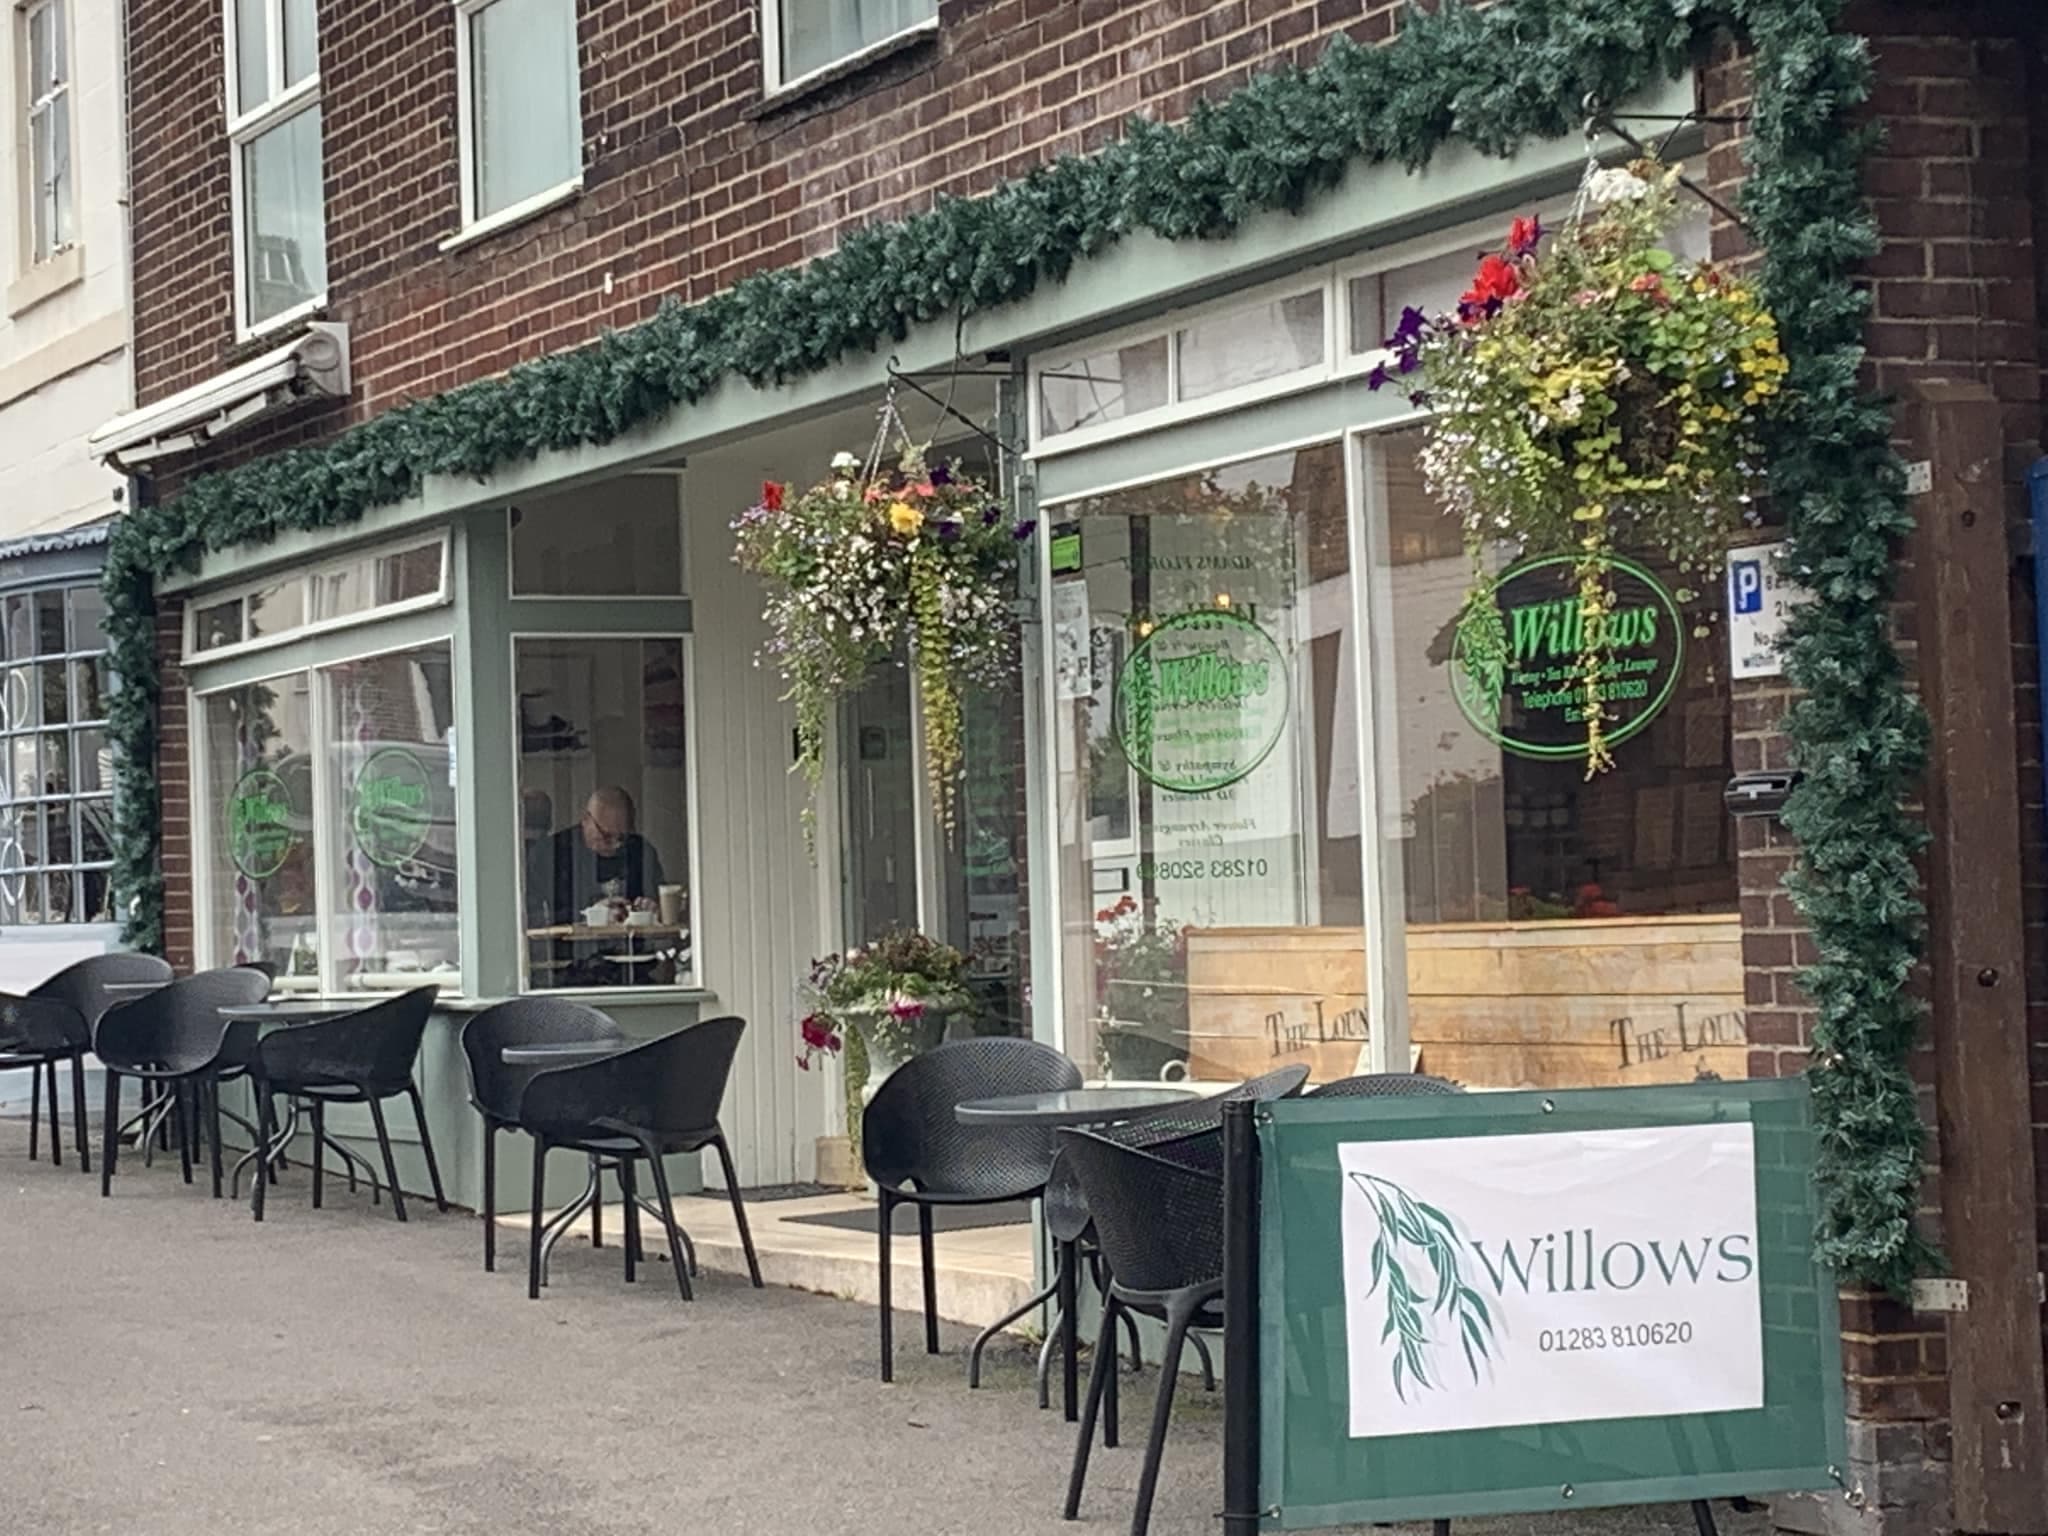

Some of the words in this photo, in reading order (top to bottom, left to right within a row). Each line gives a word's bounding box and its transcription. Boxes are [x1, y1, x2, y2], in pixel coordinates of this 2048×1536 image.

[1511, 598, 1658, 661] Willows
[1160, 652, 1270, 702] Willows
[1469, 1228, 1753, 1297] Willows
[1539, 1328, 1607, 1352] 01283
[1611, 1321, 1693, 1348] 810620
